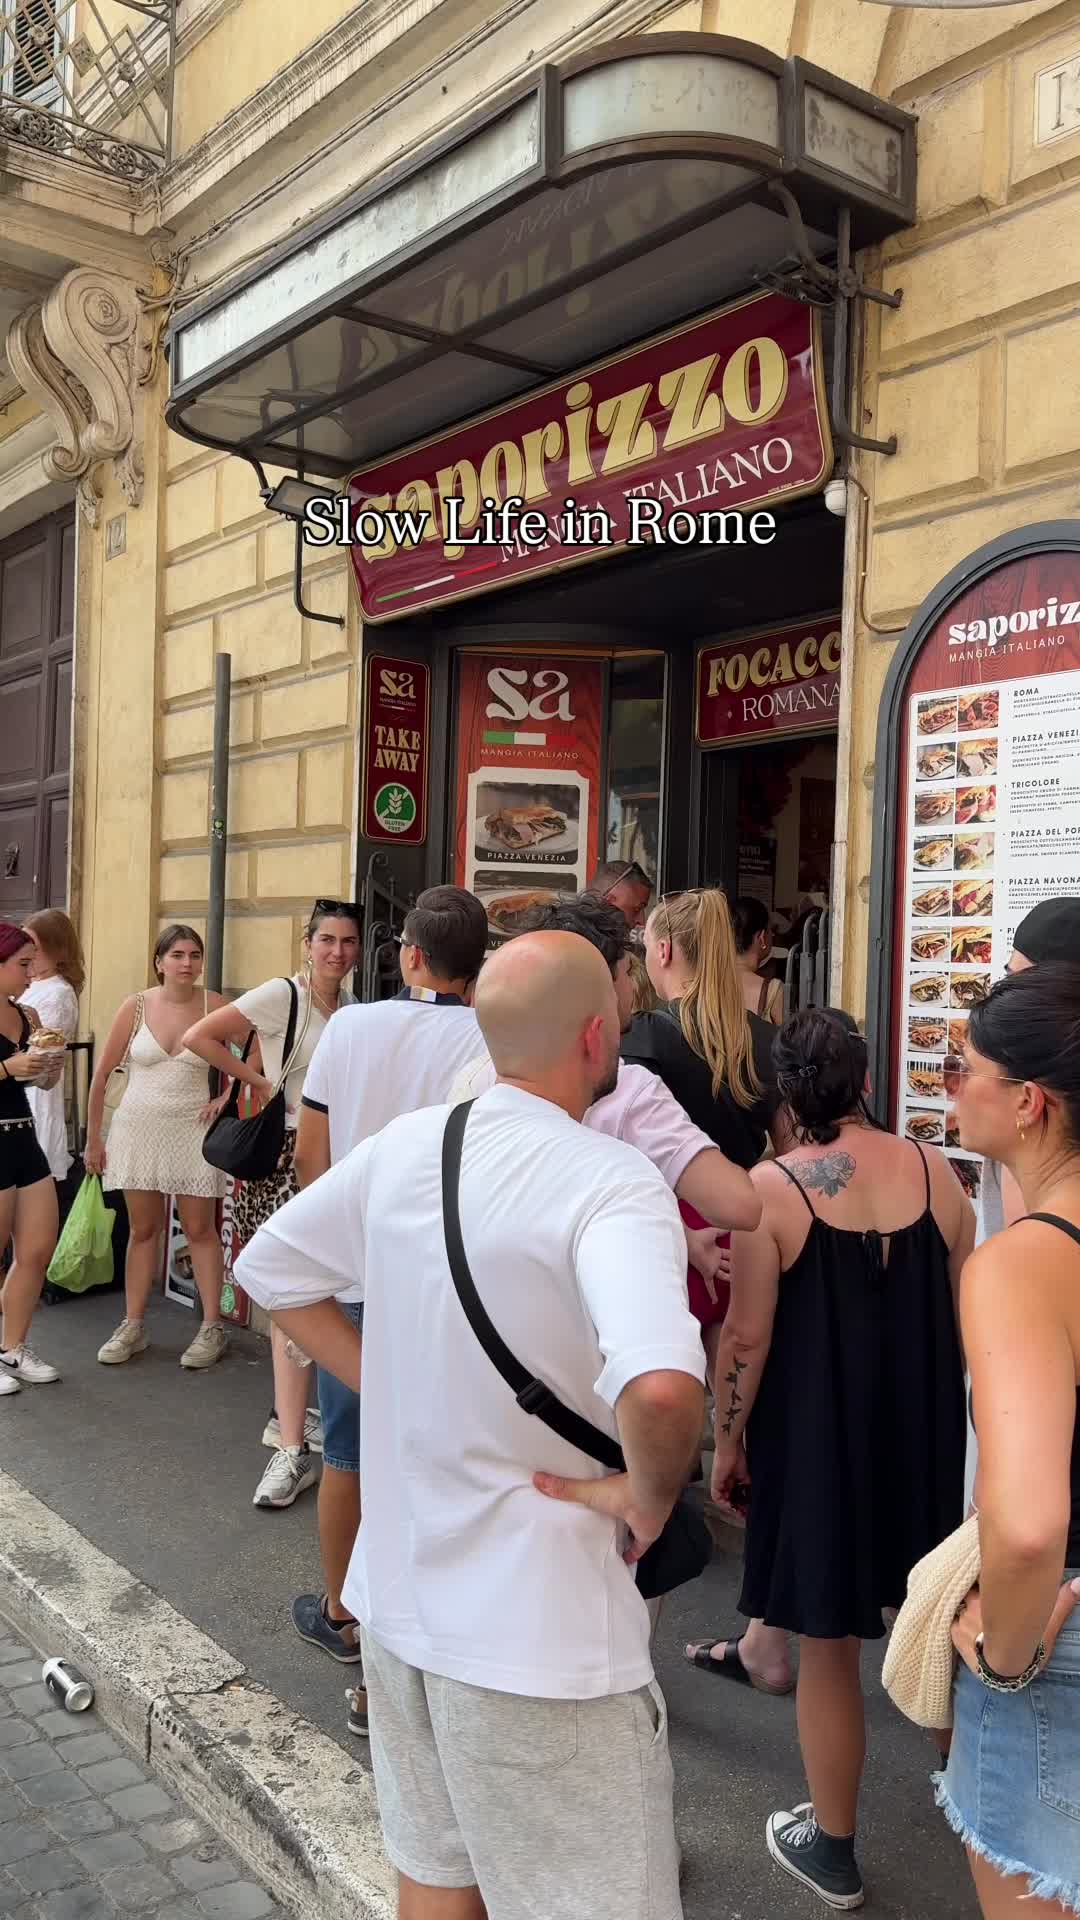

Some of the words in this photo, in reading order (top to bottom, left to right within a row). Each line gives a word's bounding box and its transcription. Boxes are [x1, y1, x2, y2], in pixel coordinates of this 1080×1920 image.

[359, 336, 789, 564] saporizzo
[948, 597, 1080, 646] saporiz
[949, 647, 997, 664] MANGIA
[1003, 635, 1065, 654] ITALIANO
[707, 631, 841, 697] FOCACC
[742, 681, 840, 722] ROMANA
[1013, 687, 1039, 697] ROMA
[374, 725, 421, 751] TAKE
[1012, 734, 1043, 744] PIAZZA
[1047, 729, 1079, 739] VENEZI
[373, 748, 420, 773] AWAY
[480, 748, 523, 757] MANGIA
[527, 750, 579, 760] ITALIANO
[1011, 778, 1060, 789] TRICOLORE
[1010, 829, 1041, 838] PIAZZA
[1045, 828, 1062, 836] DEL
[487, 852, 522, 860] PIAZZA
[525, 854, 566, 862] VENEZIA
[1009, 878, 1040, 886] PIAZZA
